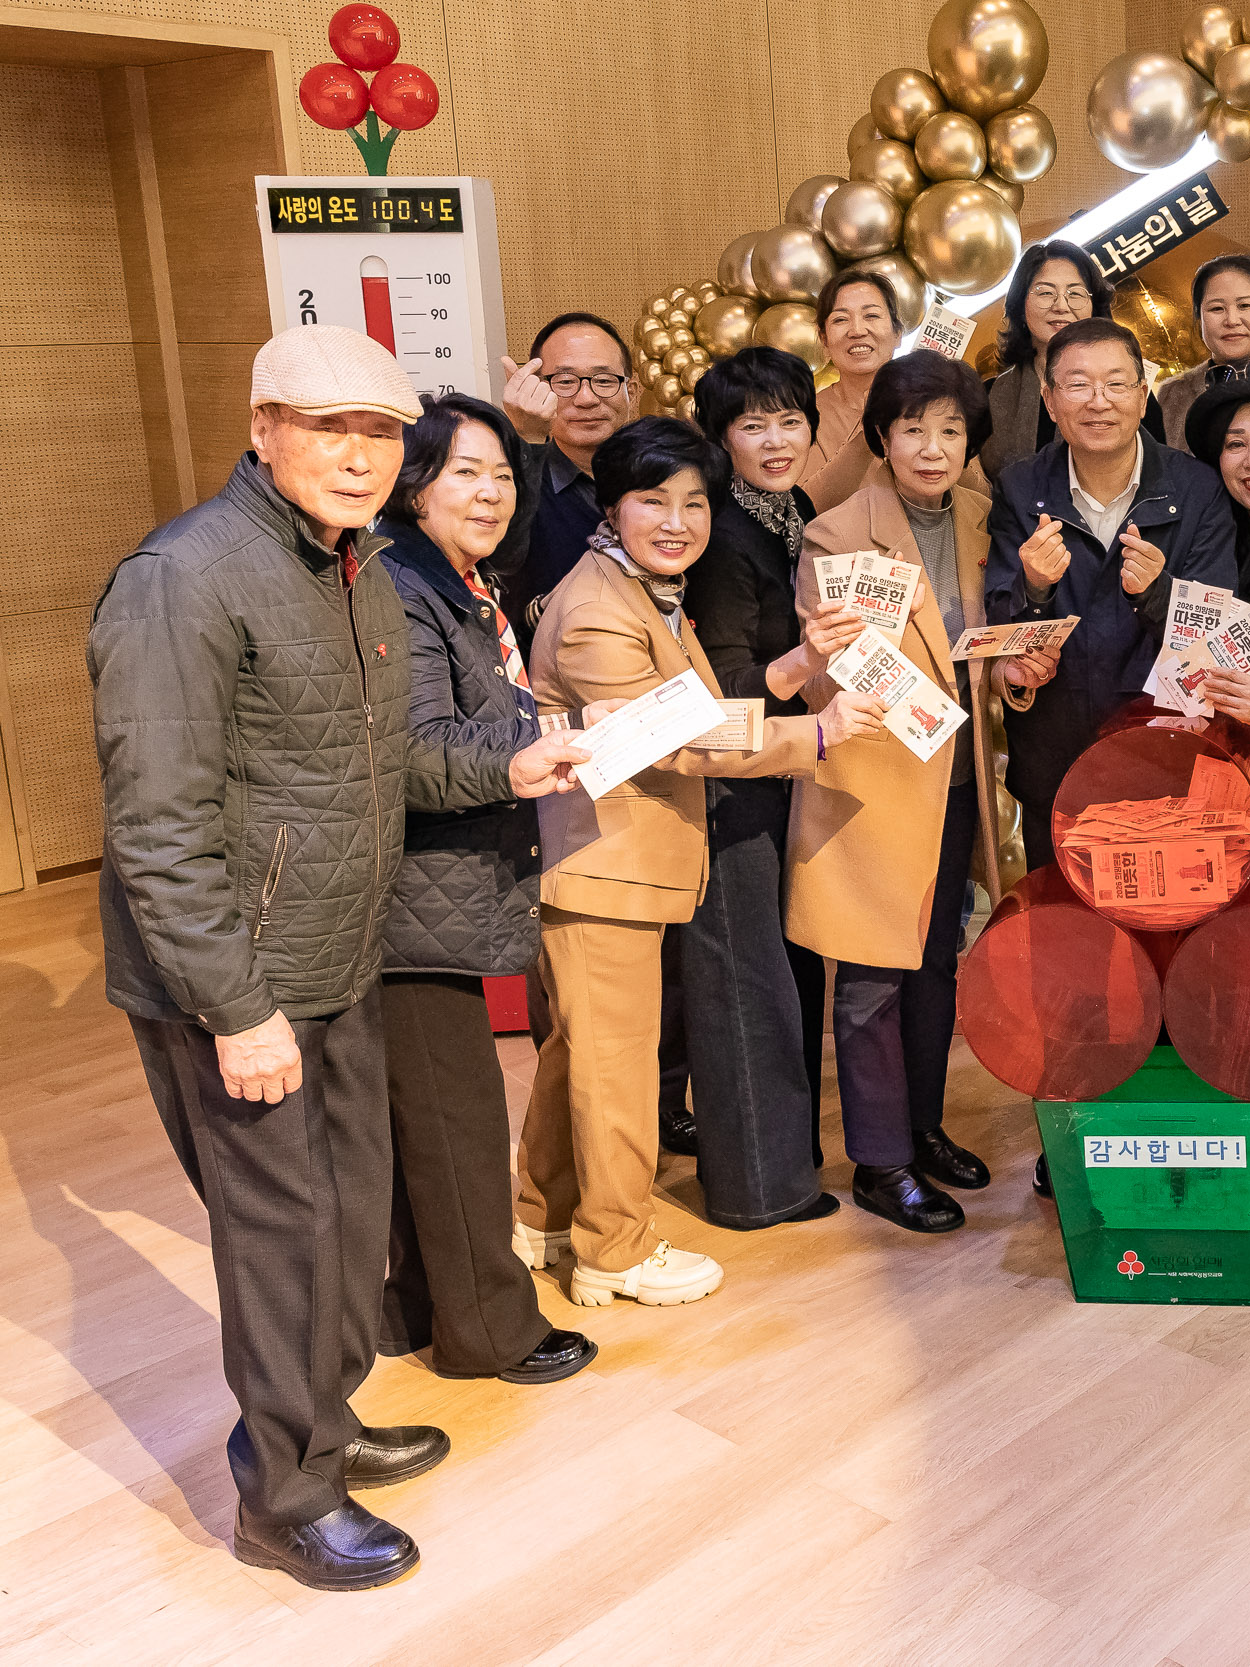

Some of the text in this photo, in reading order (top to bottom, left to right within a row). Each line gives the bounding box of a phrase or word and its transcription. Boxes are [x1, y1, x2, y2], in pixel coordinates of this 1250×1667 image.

[278, 197, 322, 223] 사랑의
[328, 197, 358, 223] 온도
[439, 199, 454, 221] 도
[1090, 184, 1217, 277] 나눔의 날
[426, 273, 450, 284] 100
[431, 308, 448, 320] 90
[920, 336, 956, 358] 겨울나기
[924, 325, 962, 350] 따뜻한
[435, 346, 451, 358] 80
[438, 385, 455, 395] 70
[860, 574, 878, 584] 2026
[854, 582, 906, 604] 따뜻한
[852, 595, 902, 615] 겨울나기
[1176, 602, 1193, 610] 2026
[1174, 609, 1220, 630] 따뜻한
[849, 668, 864, 685] 2026
[856, 652, 895, 693] 따뜻한
[1122, 852, 1138, 898] 따뜻한
[1089, 1140, 1240, 1163] 감사합니다!
